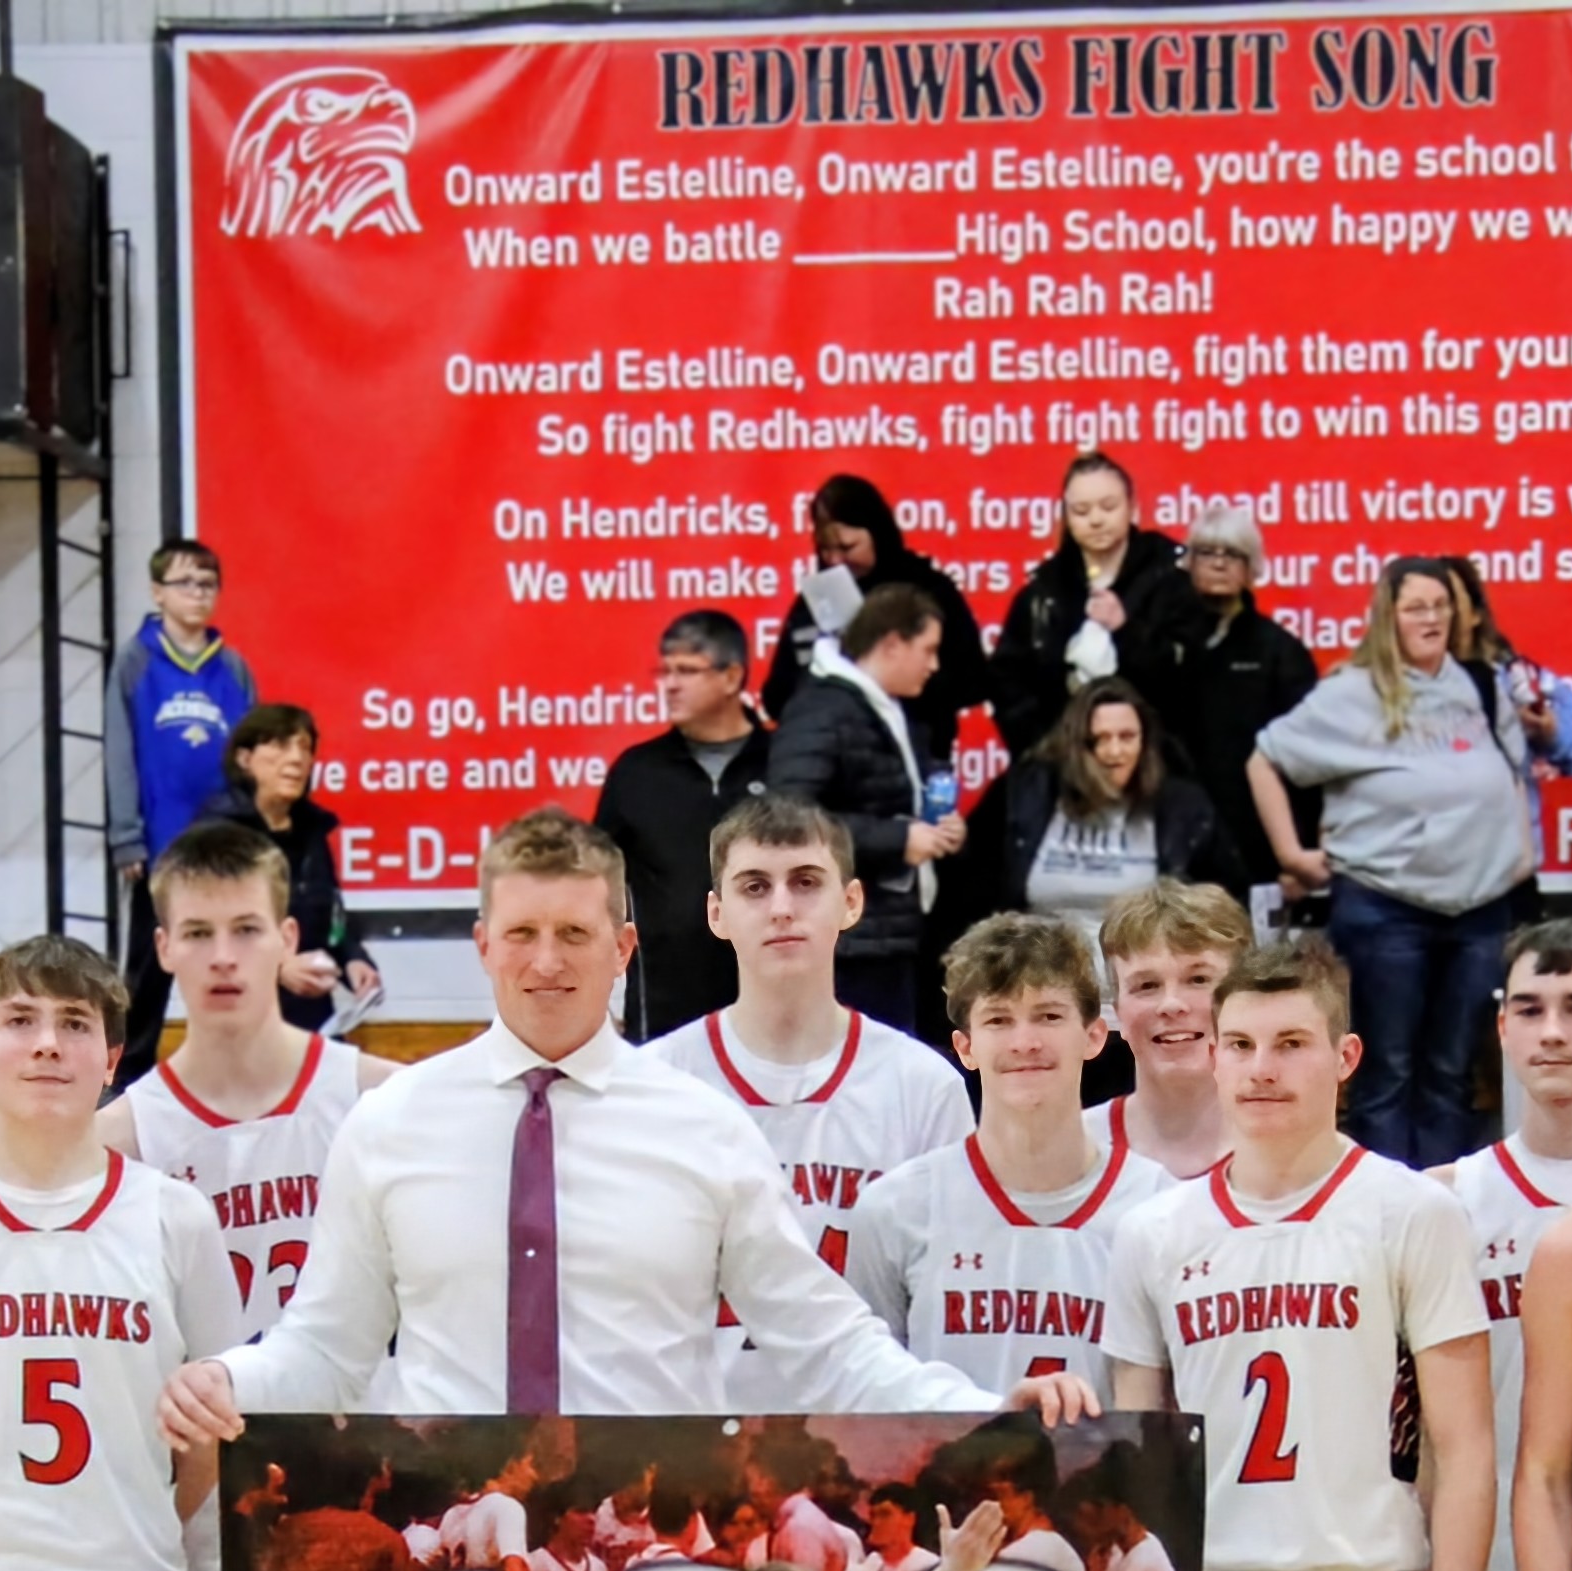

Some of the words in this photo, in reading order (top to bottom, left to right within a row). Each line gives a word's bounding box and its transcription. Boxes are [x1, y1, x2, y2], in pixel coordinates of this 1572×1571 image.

[661, 40, 1042, 129] REDHAWKS
[1072, 33, 1284, 115] FIGHT
[1313, 25, 1494, 108] SONG
[444, 159, 604, 207] Onward
[615, 154, 806, 203] Estelline,
[817, 148, 979, 196] Onward
[990, 144, 1184, 192] Estelline,
[1194, 139, 1322, 197] you're
[1333, 137, 1403, 182] the
[1414, 130, 1558, 179] school
[462, 225, 580, 271] When
[590, 231, 653, 266] we
[663, 219, 784, 265] battle
[955, 210, 1051, 265] High
[1062, 205, 1218, 256] School,
[1229, 204, 1319, 249] how
[1330, 203, 1459, 256] happy
[1468, 207, 1532, 241] we
[933, 275, 1015, 320] Rah
[1026, 272, 1108, 317] Rah
[1119, 269, 1214, 316] Rah!
[443, 348, 604, 396] Onward
[615, 345, 806, 393] Estelline,
[816, 339, 977, 387] Onward
[988, 335, 1182, 384] Estelline,
[1192, 332, 1289, 388] fight
[1299, 331, 1410, 375] them
[1420, 327, 1485, 372] for
[536, 412, 591, 457] So
[601, 411, 695, 466] fight
[707, 403, 930, 453] Redhawks,
[939, 402, 1035, 457] fight
[1045, 399, 1141, 454] fight
[1151, 397, 1248, 453] fight
[1258, 399, 1302, 440] to
[1312, 394, 1390, 438] win
[1400, 391, 1482, 436] this
[493, 498, 549, 542] On
[560, 493, 780, 540] Hendricks,
[894, 498, 958, 537] on,
[1292, 479, 1350, 524] till
[1360, 478, 1508, 531] victory
[1517, 475, 1556, 519] is
[505, 560, 569, 604] We
[579, 558, 657, 601] will
[666, 555, 780, 600] make
[1467, 538, 1544, 583] and
[361, 687, 416, 730] So
[426, 695, 487, 740] go,
[497, 678, 671, 728] Hendric
[310, 760, 348, 793] e
[358, 758, 450, 792] care
[461, 747, 537, 790] and
[547, 755, 609, 788] we
[949, 737, 1012, 790] igh
[339, 824, 492, 882] E-D-
[212, 1174, 319, 1229] DHAW
[944, 1289, 1103, 1344] REDHAW
[1176, 1284, 1361, 1346] REDHAWKS
[19, 1357, 93, 1486] 5
[1236, 1350, 1299, 1485] 2
